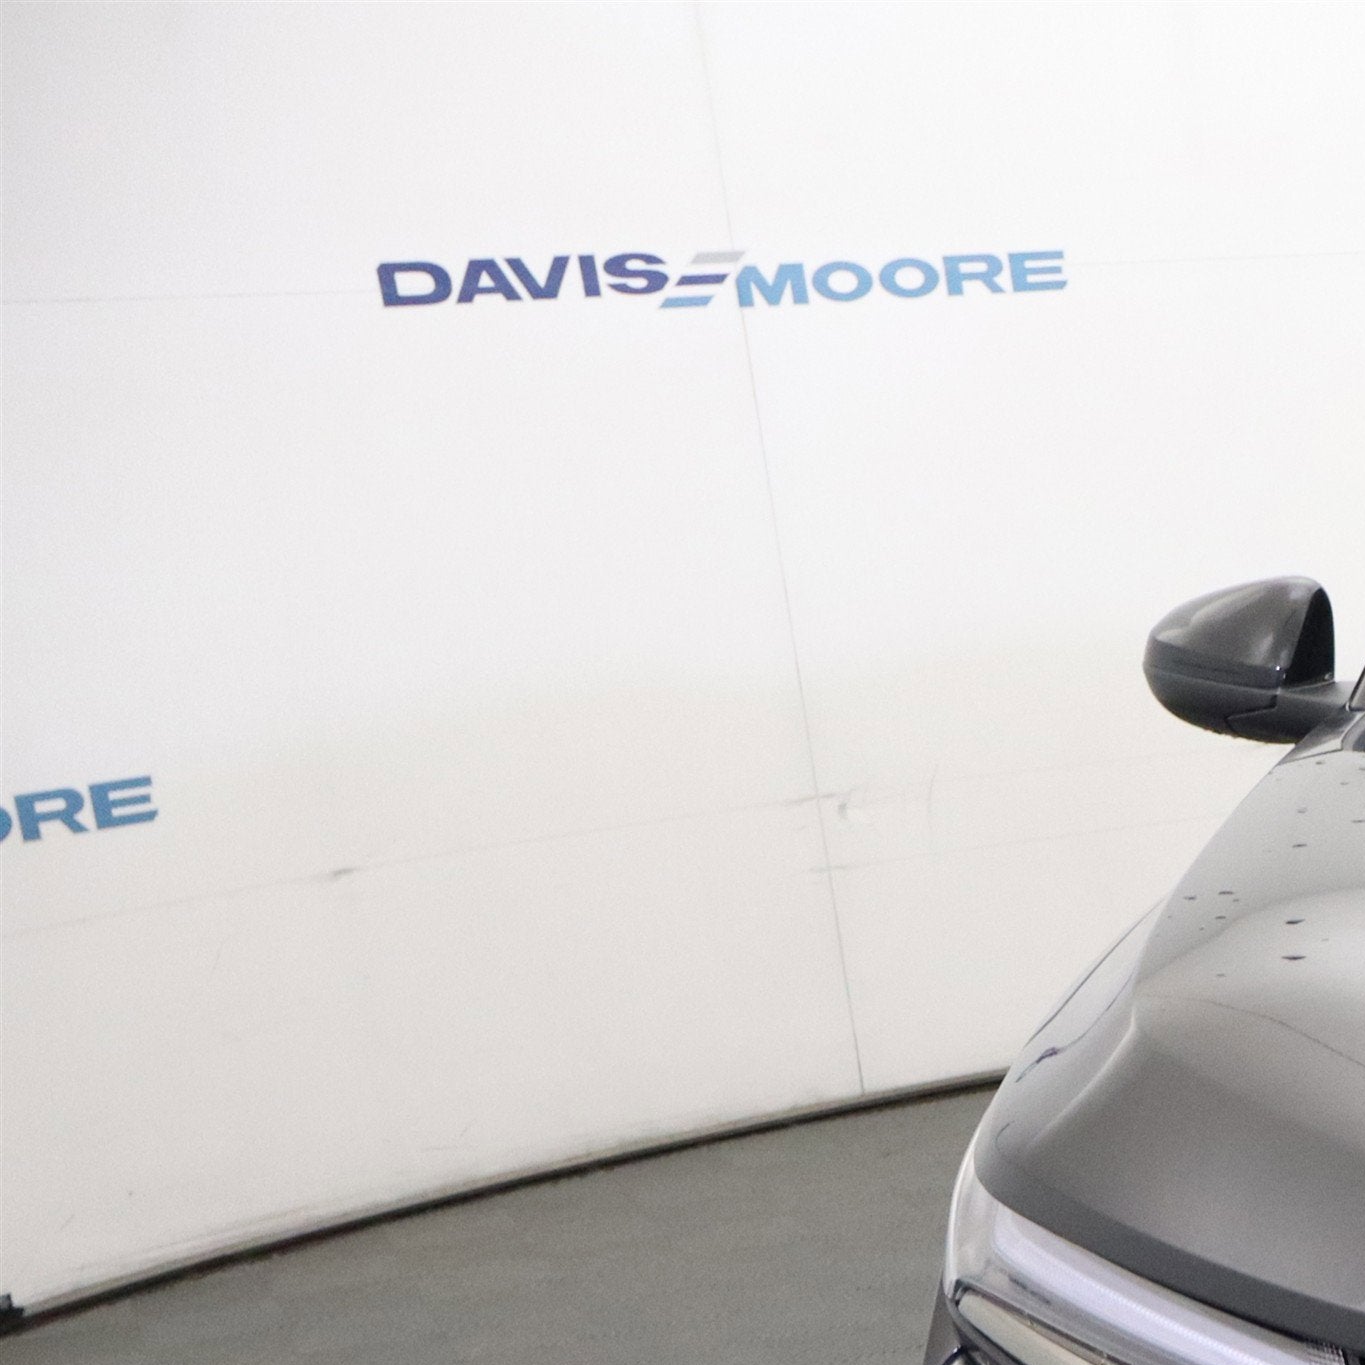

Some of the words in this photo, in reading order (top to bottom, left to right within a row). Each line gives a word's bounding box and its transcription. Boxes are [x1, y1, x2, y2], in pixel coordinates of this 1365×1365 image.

[377, 251, 668, 308] DAVIS
[735, 249, 1069, 308] MOORE
[0, 774, 160, 844] RE
